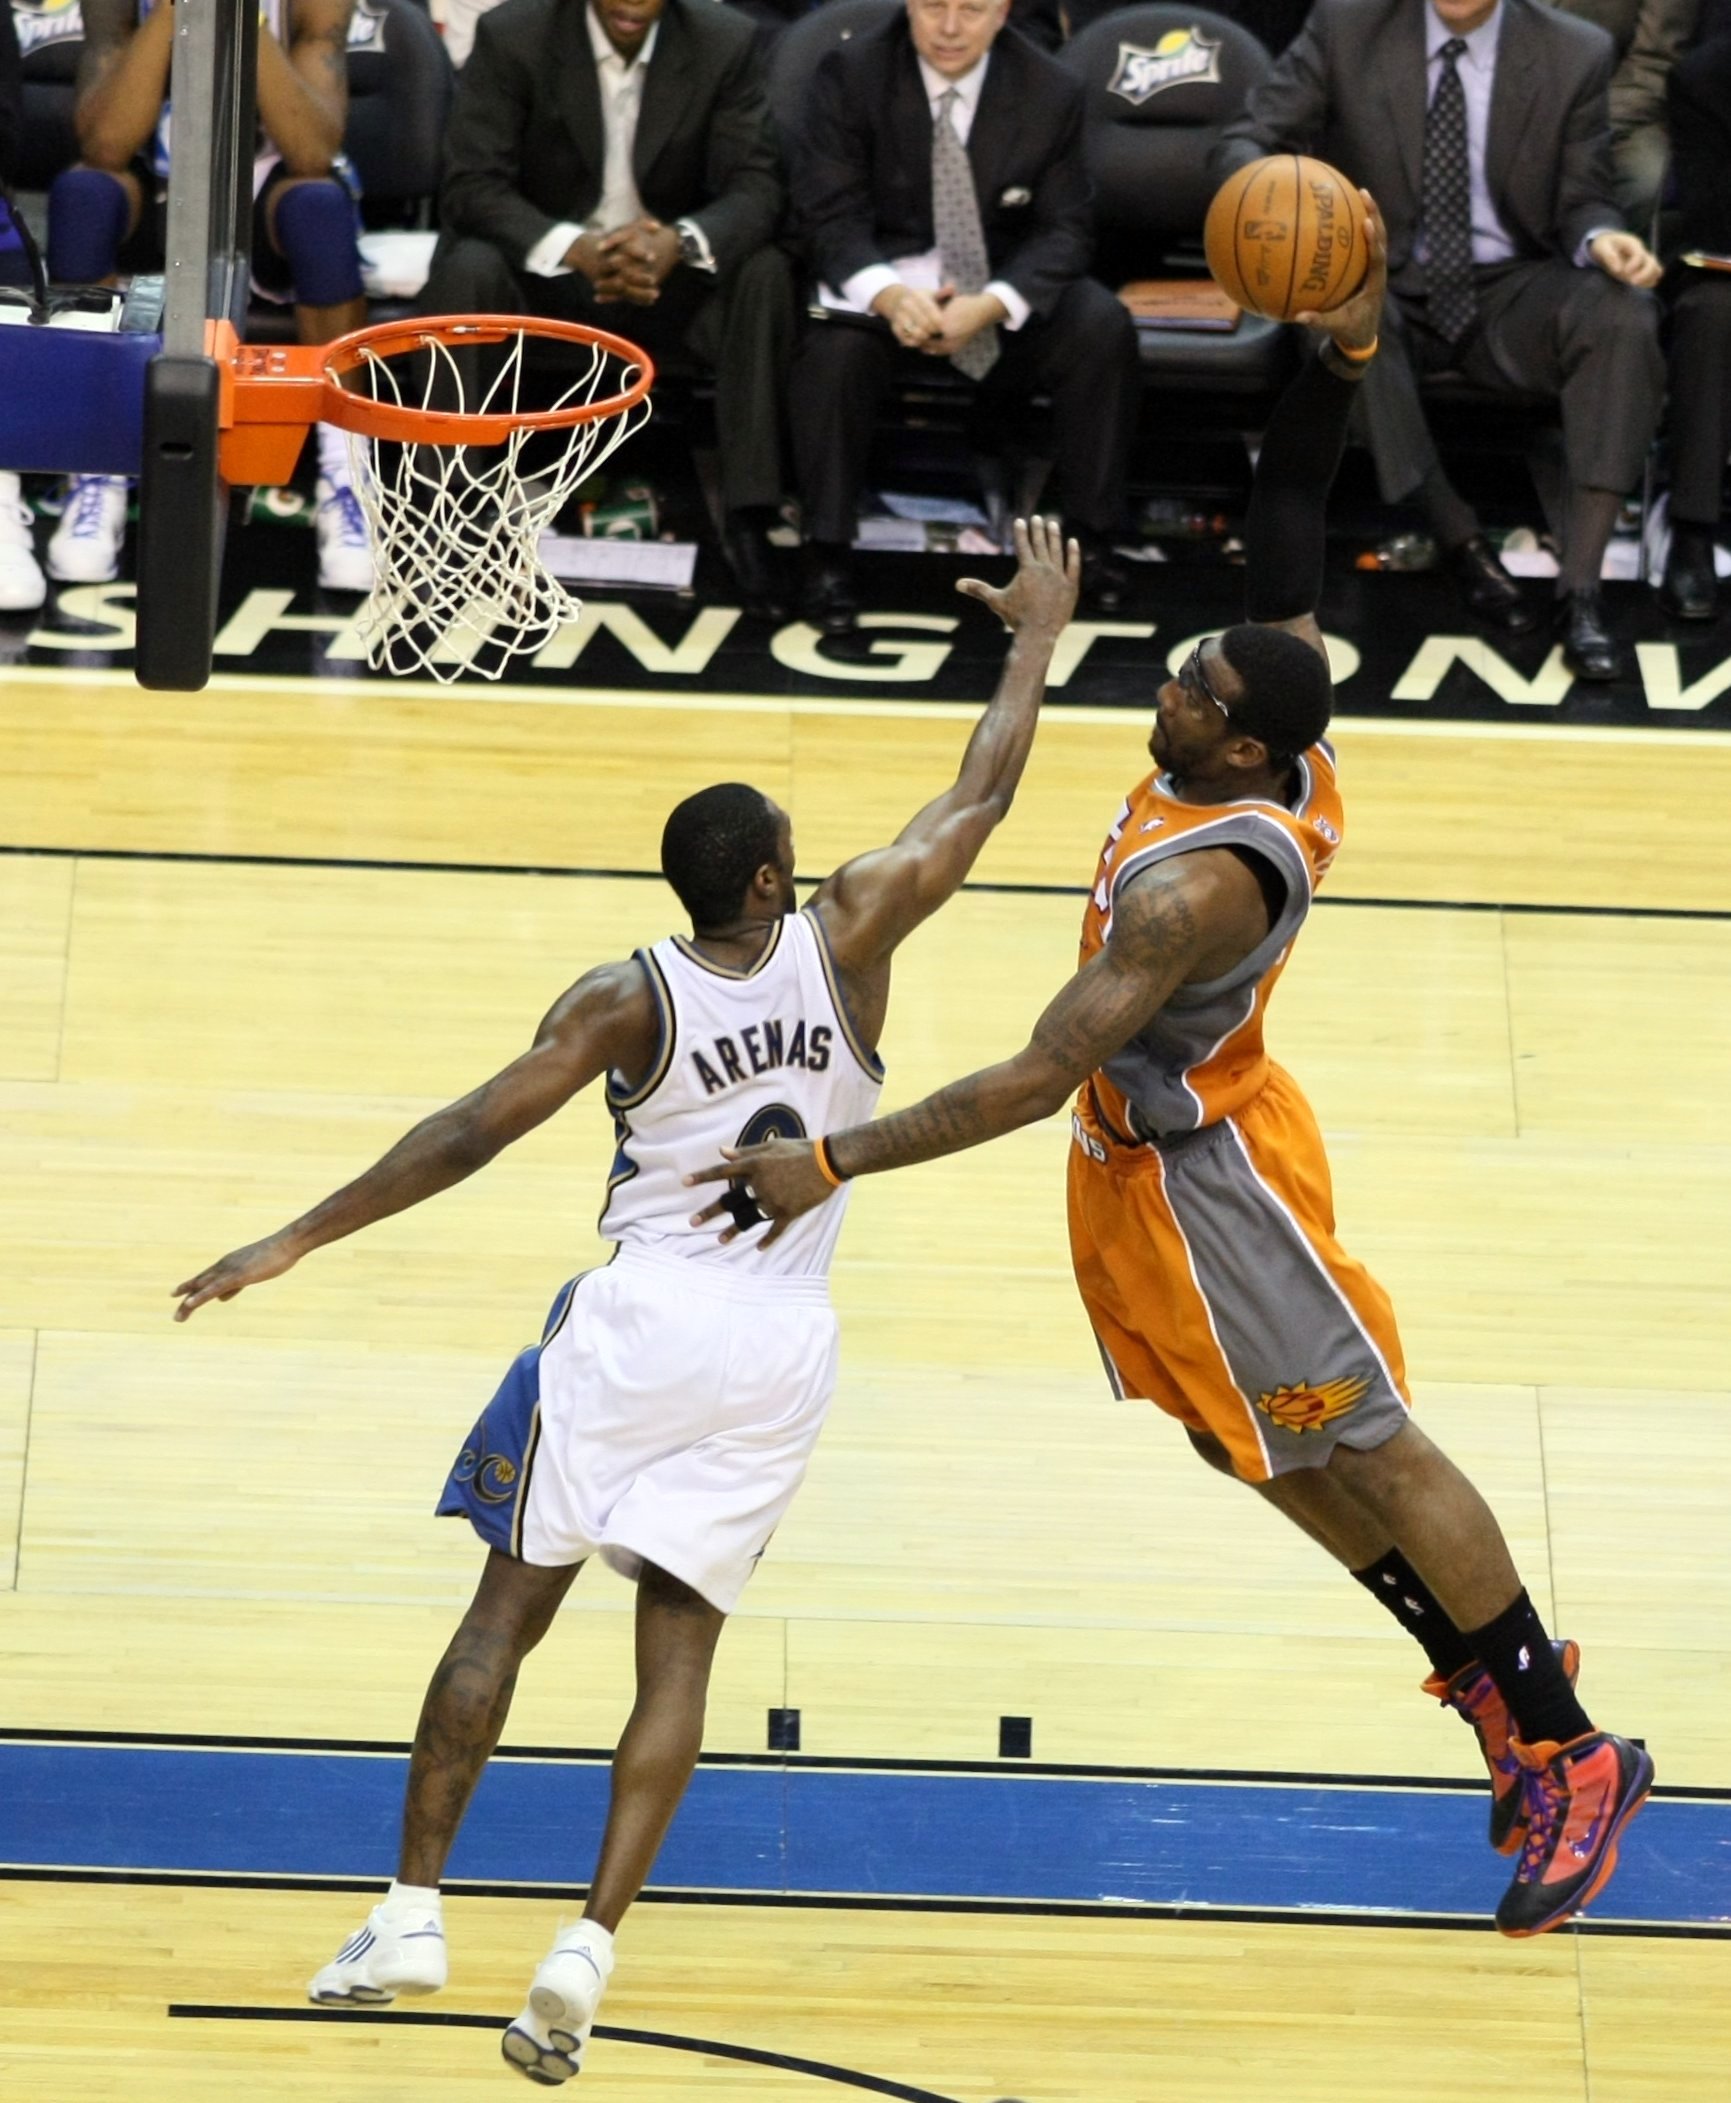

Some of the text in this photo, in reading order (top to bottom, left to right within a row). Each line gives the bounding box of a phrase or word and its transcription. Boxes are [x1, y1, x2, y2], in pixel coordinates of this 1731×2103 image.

[1120, 40, 1210, 94] Sprite
[1301, 180, 1334, 292] SPALDING
[690, 1019, 833, 1095] ARENAS
